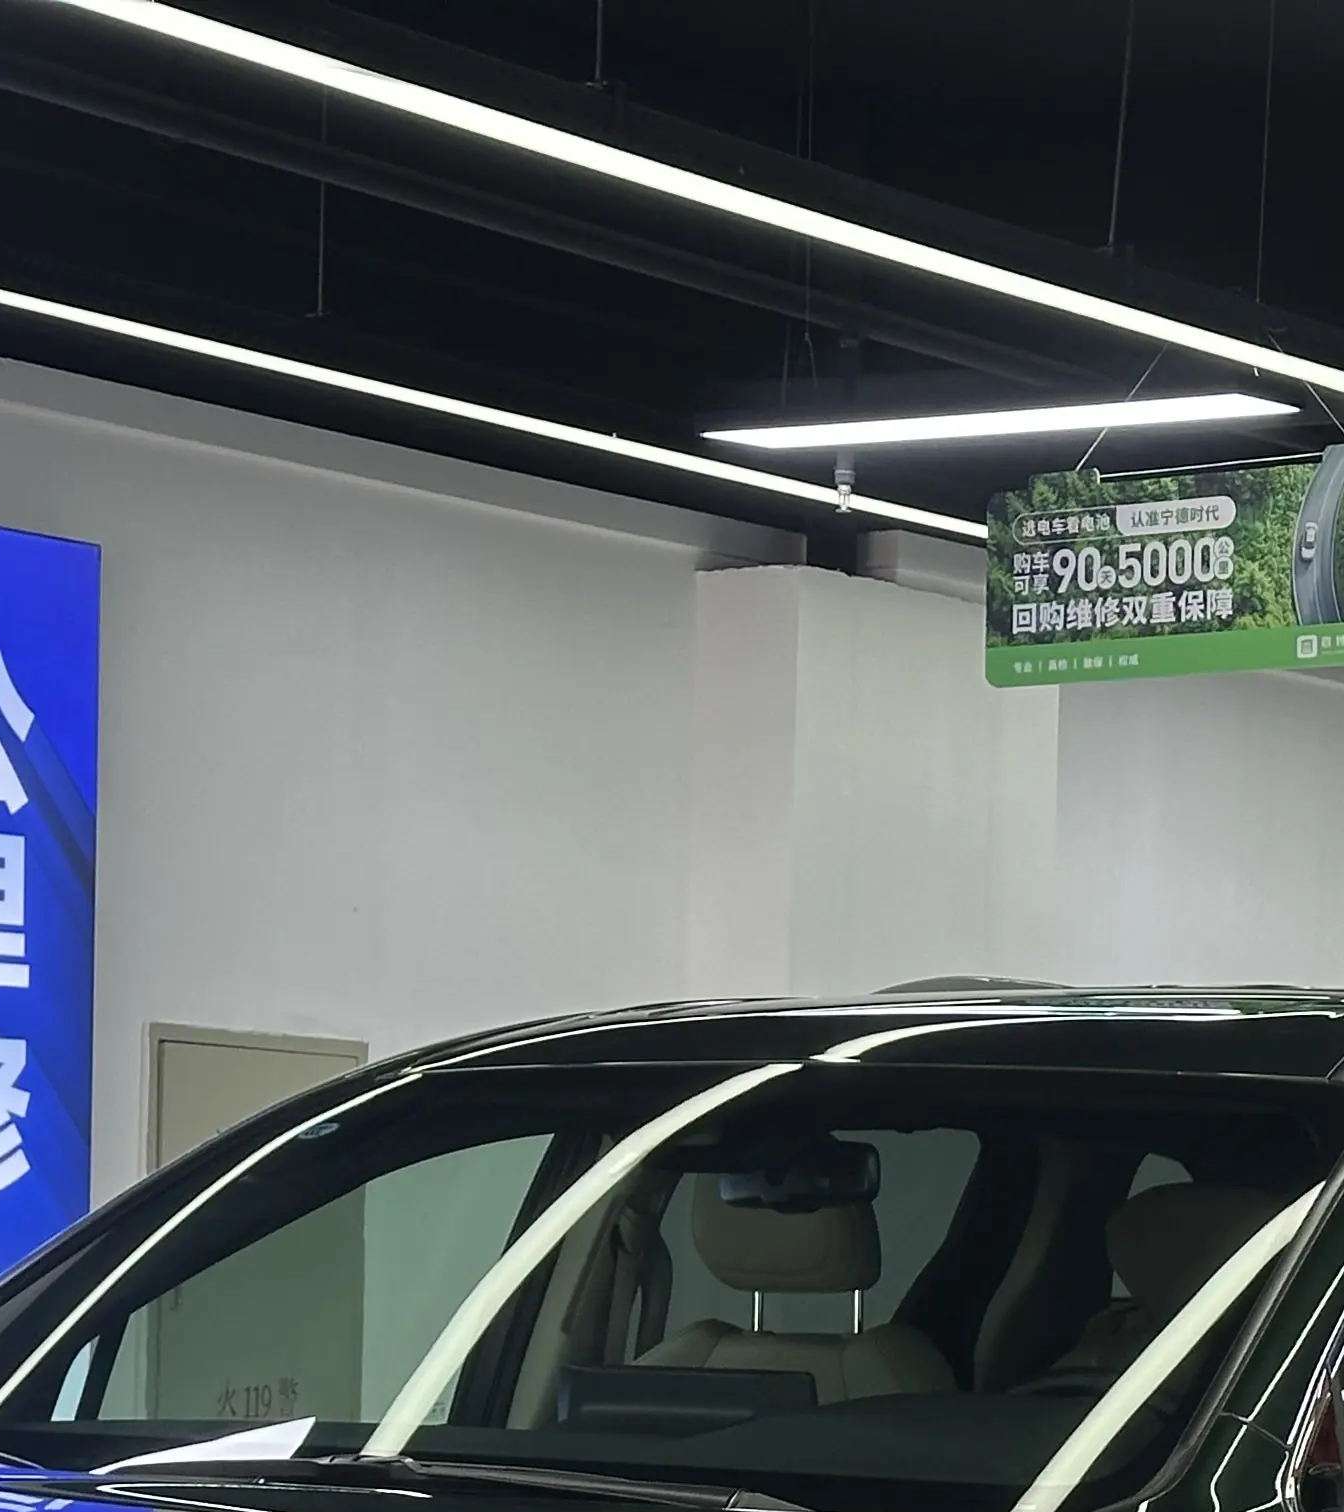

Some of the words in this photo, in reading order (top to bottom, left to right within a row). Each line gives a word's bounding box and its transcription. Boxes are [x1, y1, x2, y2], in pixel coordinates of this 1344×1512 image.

[1012, 588, 1234, 634] 回购维修双重保障
